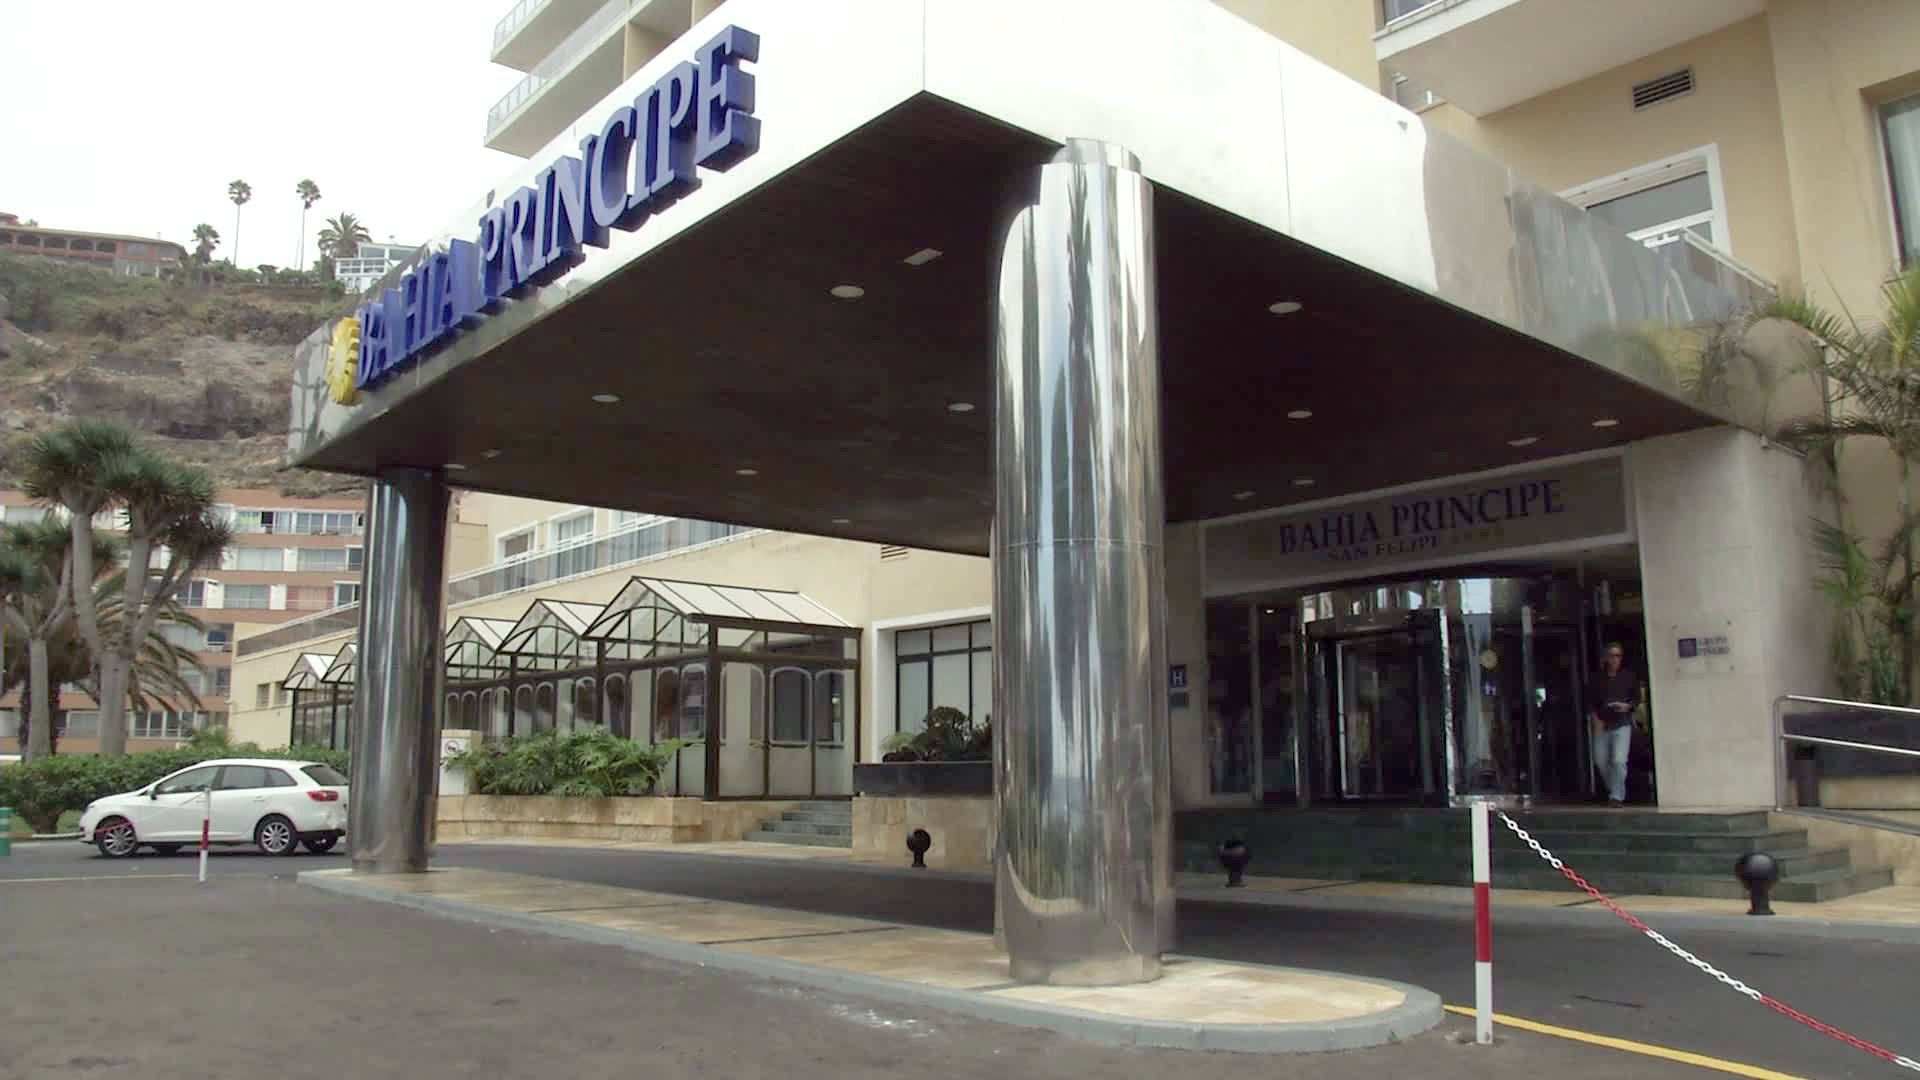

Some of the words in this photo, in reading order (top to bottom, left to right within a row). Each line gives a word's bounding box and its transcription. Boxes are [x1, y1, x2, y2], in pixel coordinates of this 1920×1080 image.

[357, 239, 484, 390] BAHIA
[479, 24, 761, 308] PRINCIPE
[1279, 510, 1382, 555] BAHIA
[1391, 480, 1565, 537] PRINCIPE
